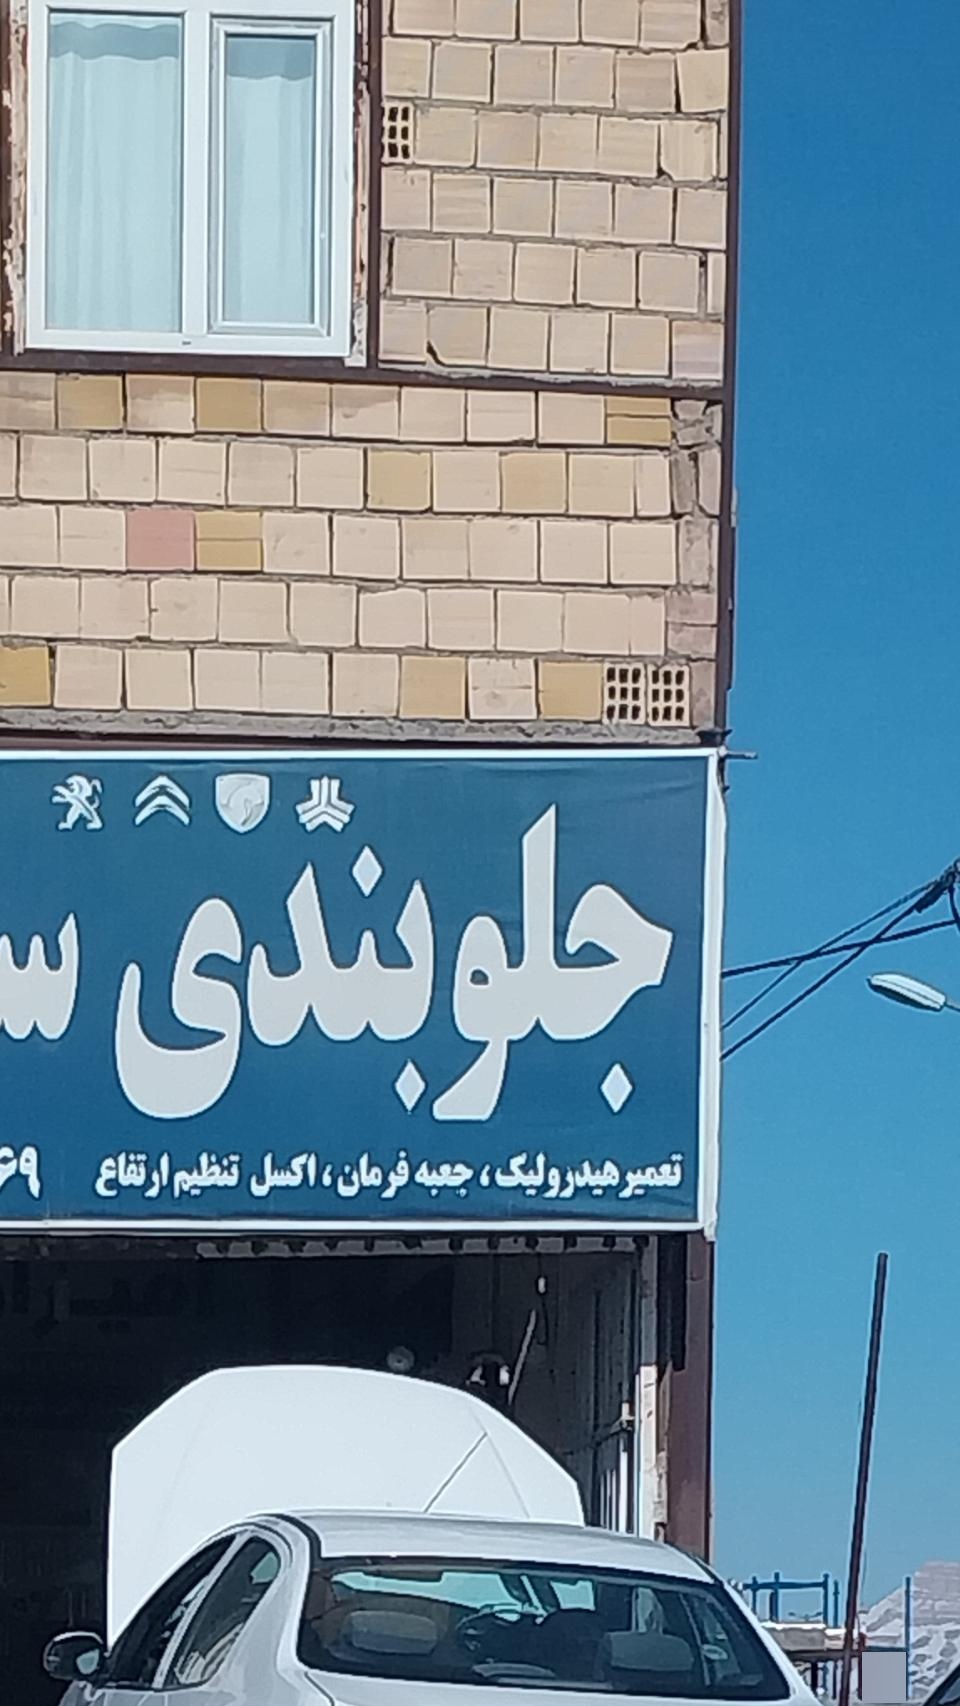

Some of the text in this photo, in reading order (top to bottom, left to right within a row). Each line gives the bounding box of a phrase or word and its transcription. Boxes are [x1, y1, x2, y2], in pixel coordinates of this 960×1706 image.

[95, 1152, 169, 1198] ارتفاع
[173, 1152, 240, 1198] تنظیم
[250, 1152, 317, 1197] اکسل
[337, 1150, 410, 1199] فرمان
[414, 1160, 474, 1197] جعبه
[494, 1152, 620, 1198] هیدرولیک
[619, 1153, 684, 1198] تعمیر
